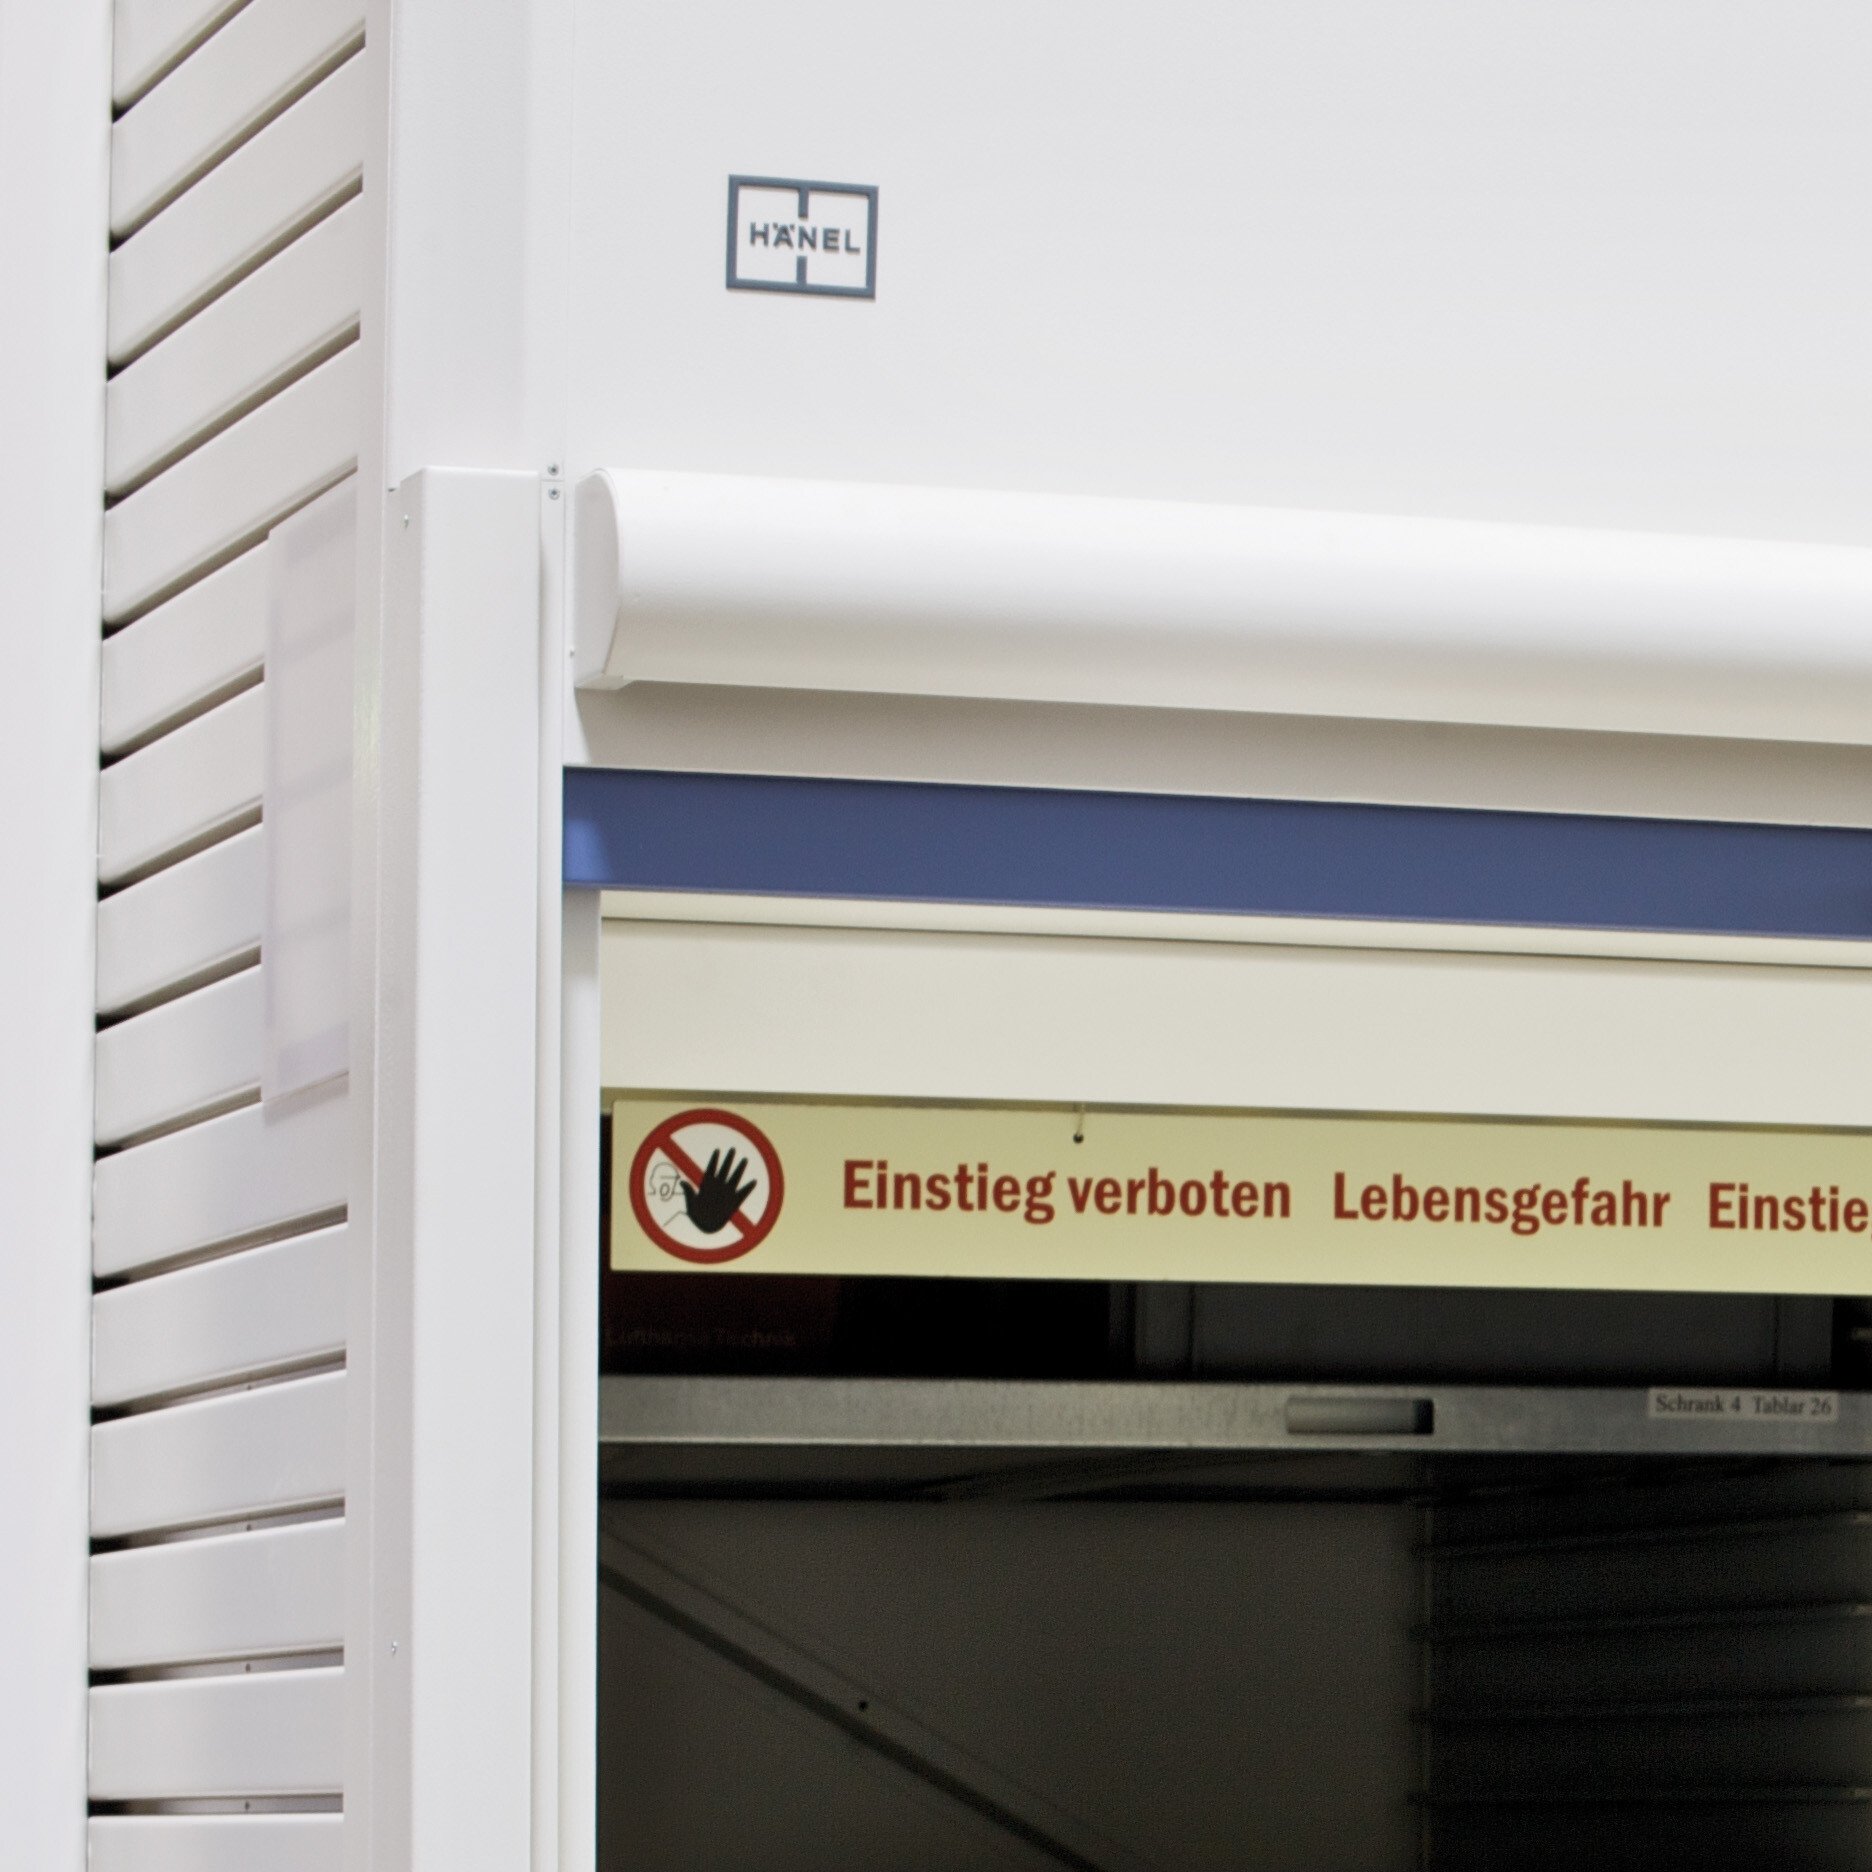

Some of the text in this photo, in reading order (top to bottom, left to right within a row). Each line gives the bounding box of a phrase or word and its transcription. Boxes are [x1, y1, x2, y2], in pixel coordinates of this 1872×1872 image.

[749, 222, 861, 254] HÄNEL
[842, 1158, 1056, 1226] Einstieg
[1067, 1166, 1292, 1219] verboten
[1333, 1172, 1671, 1237] Lebensgefahr
[1655, 1392, 1725, 1413] Schrank
[1731, 1395, 1741, 1412] 4
[1753, 1395, 1805, 1415] Tablar
